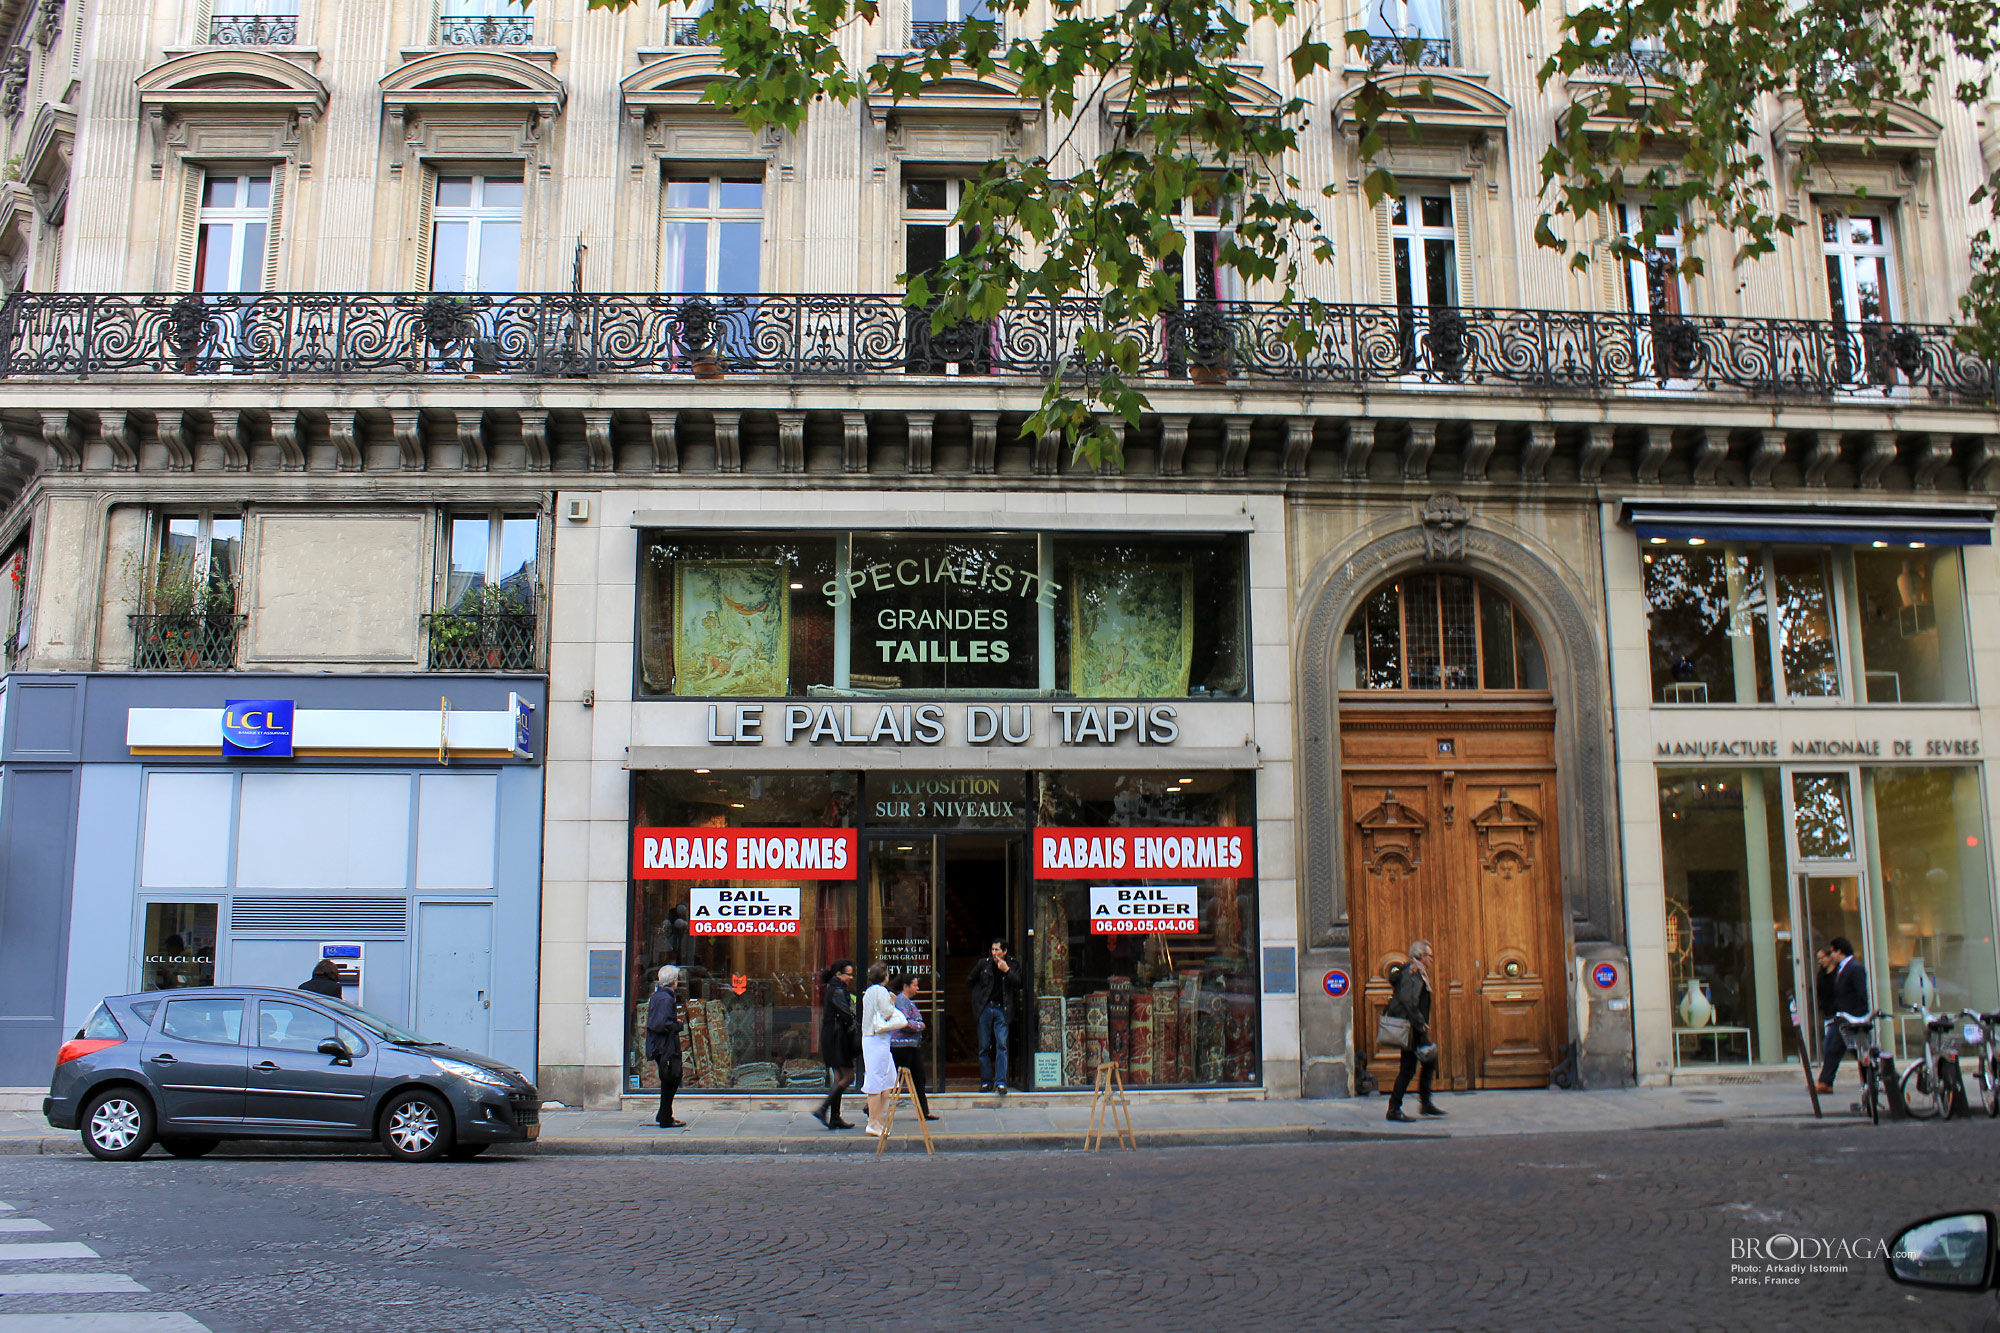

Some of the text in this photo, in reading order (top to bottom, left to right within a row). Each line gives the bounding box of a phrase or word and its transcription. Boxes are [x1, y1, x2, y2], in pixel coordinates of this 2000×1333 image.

[822, 557, 1062, 610] SPECIALISTE
[877, 609, 1008, 630] GRANDES
[876, 640, 1010, 662] TAILLES
[226, 711, 284, 729] LCL
[708, 705, 1180, 744] LE PALAIS DU TAPIS
[1657, 740, 1980, 757] MANUFACTURE NATIONALE DE SEVRES
[891, 778, 1000, 795] EXPOSITION
[875, 801, 1014, 817] SUR 3 NIVEAUX
[643, 837, 848, 869] RABAIS ENORMES
[1042, 836, 1243, 869] RABAIS ENORMES
[719, 891, 770, 902] BAIL
[1118, 890, 1168, 901] BAIL
[695, 905, 792, 916] A CEDER
[1095, 904, 1190, 915] A CEDER
[695, 921, 796, 933] 06.09.05.04.06
[1096, 920, 1195, 932] 06.09.05.04.06
[906, 965, 931, 974] FREE
